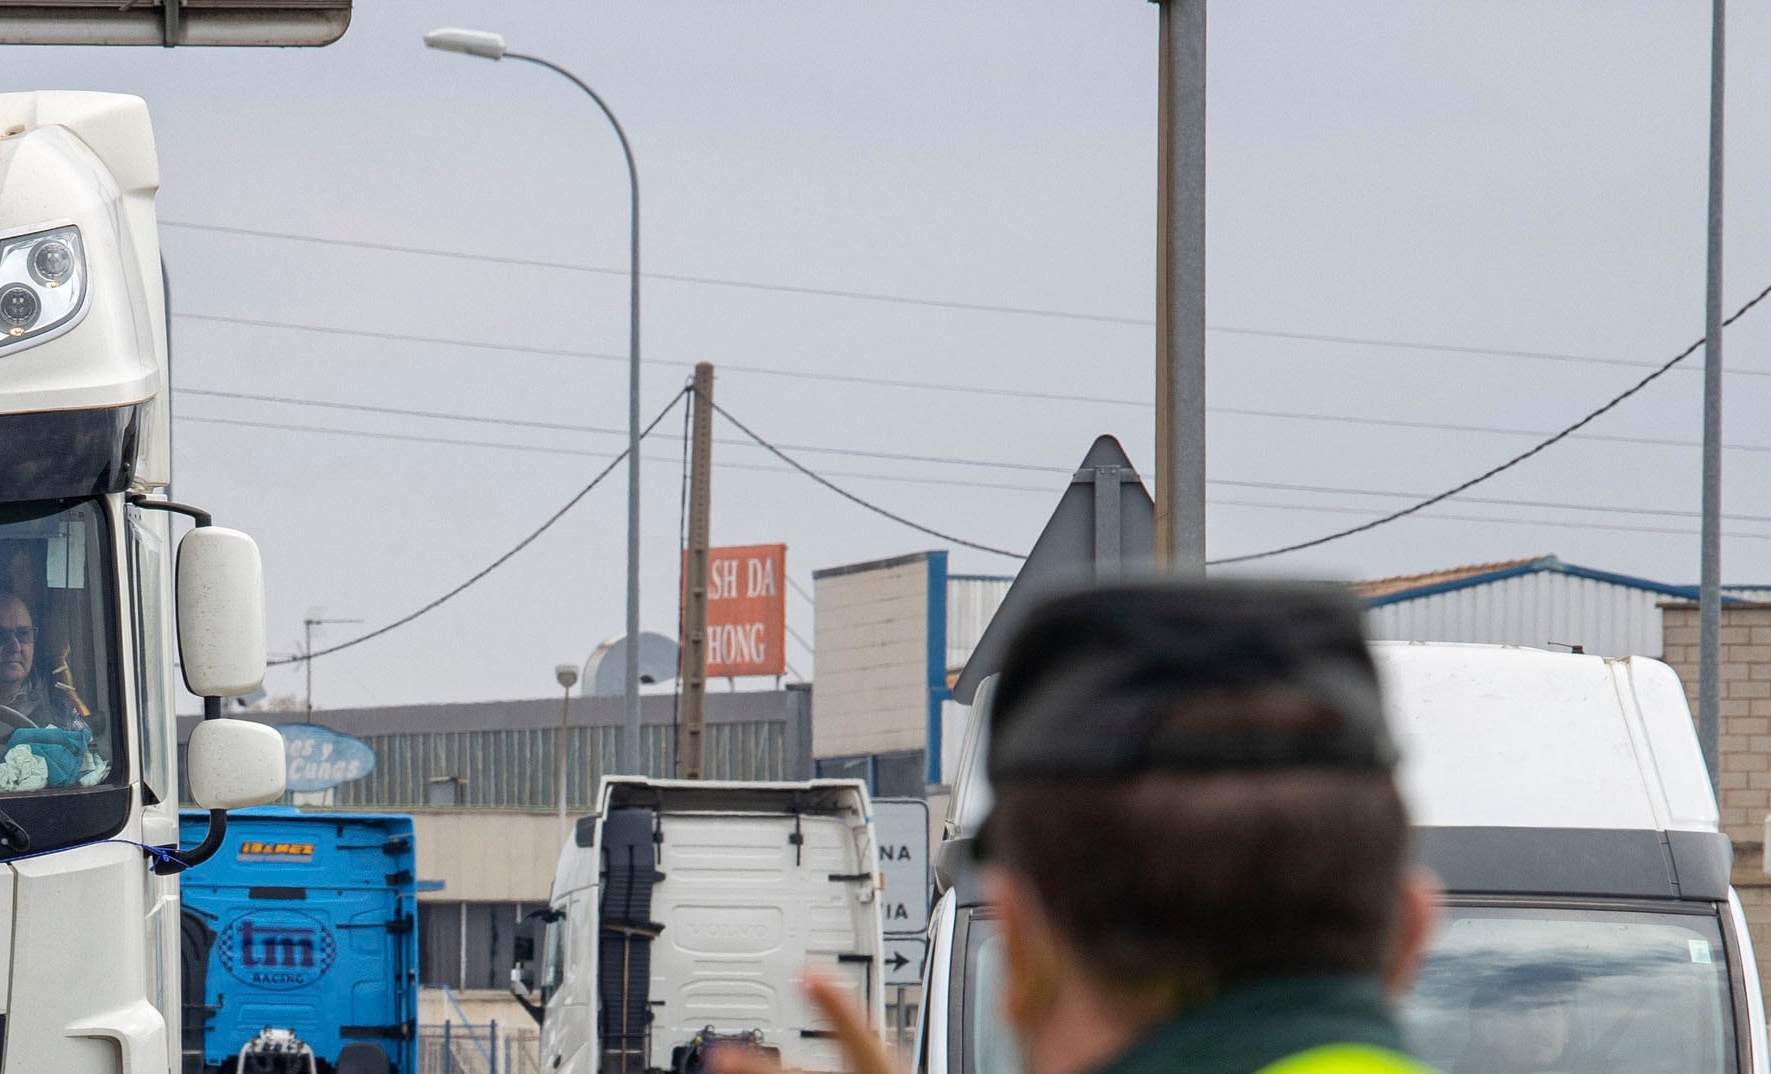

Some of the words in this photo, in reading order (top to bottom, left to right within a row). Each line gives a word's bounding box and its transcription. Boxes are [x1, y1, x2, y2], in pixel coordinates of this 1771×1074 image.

[708, 558, 738, 600] SH
[747, 557, 778, 598] DA
[707, 622, 767, 665] HONG
[284, 739, 316, 757] es
[879, 845, 912, 861] NA
[881, 903, 909, 919] IA
[253, 973, 304, 984] RACING
